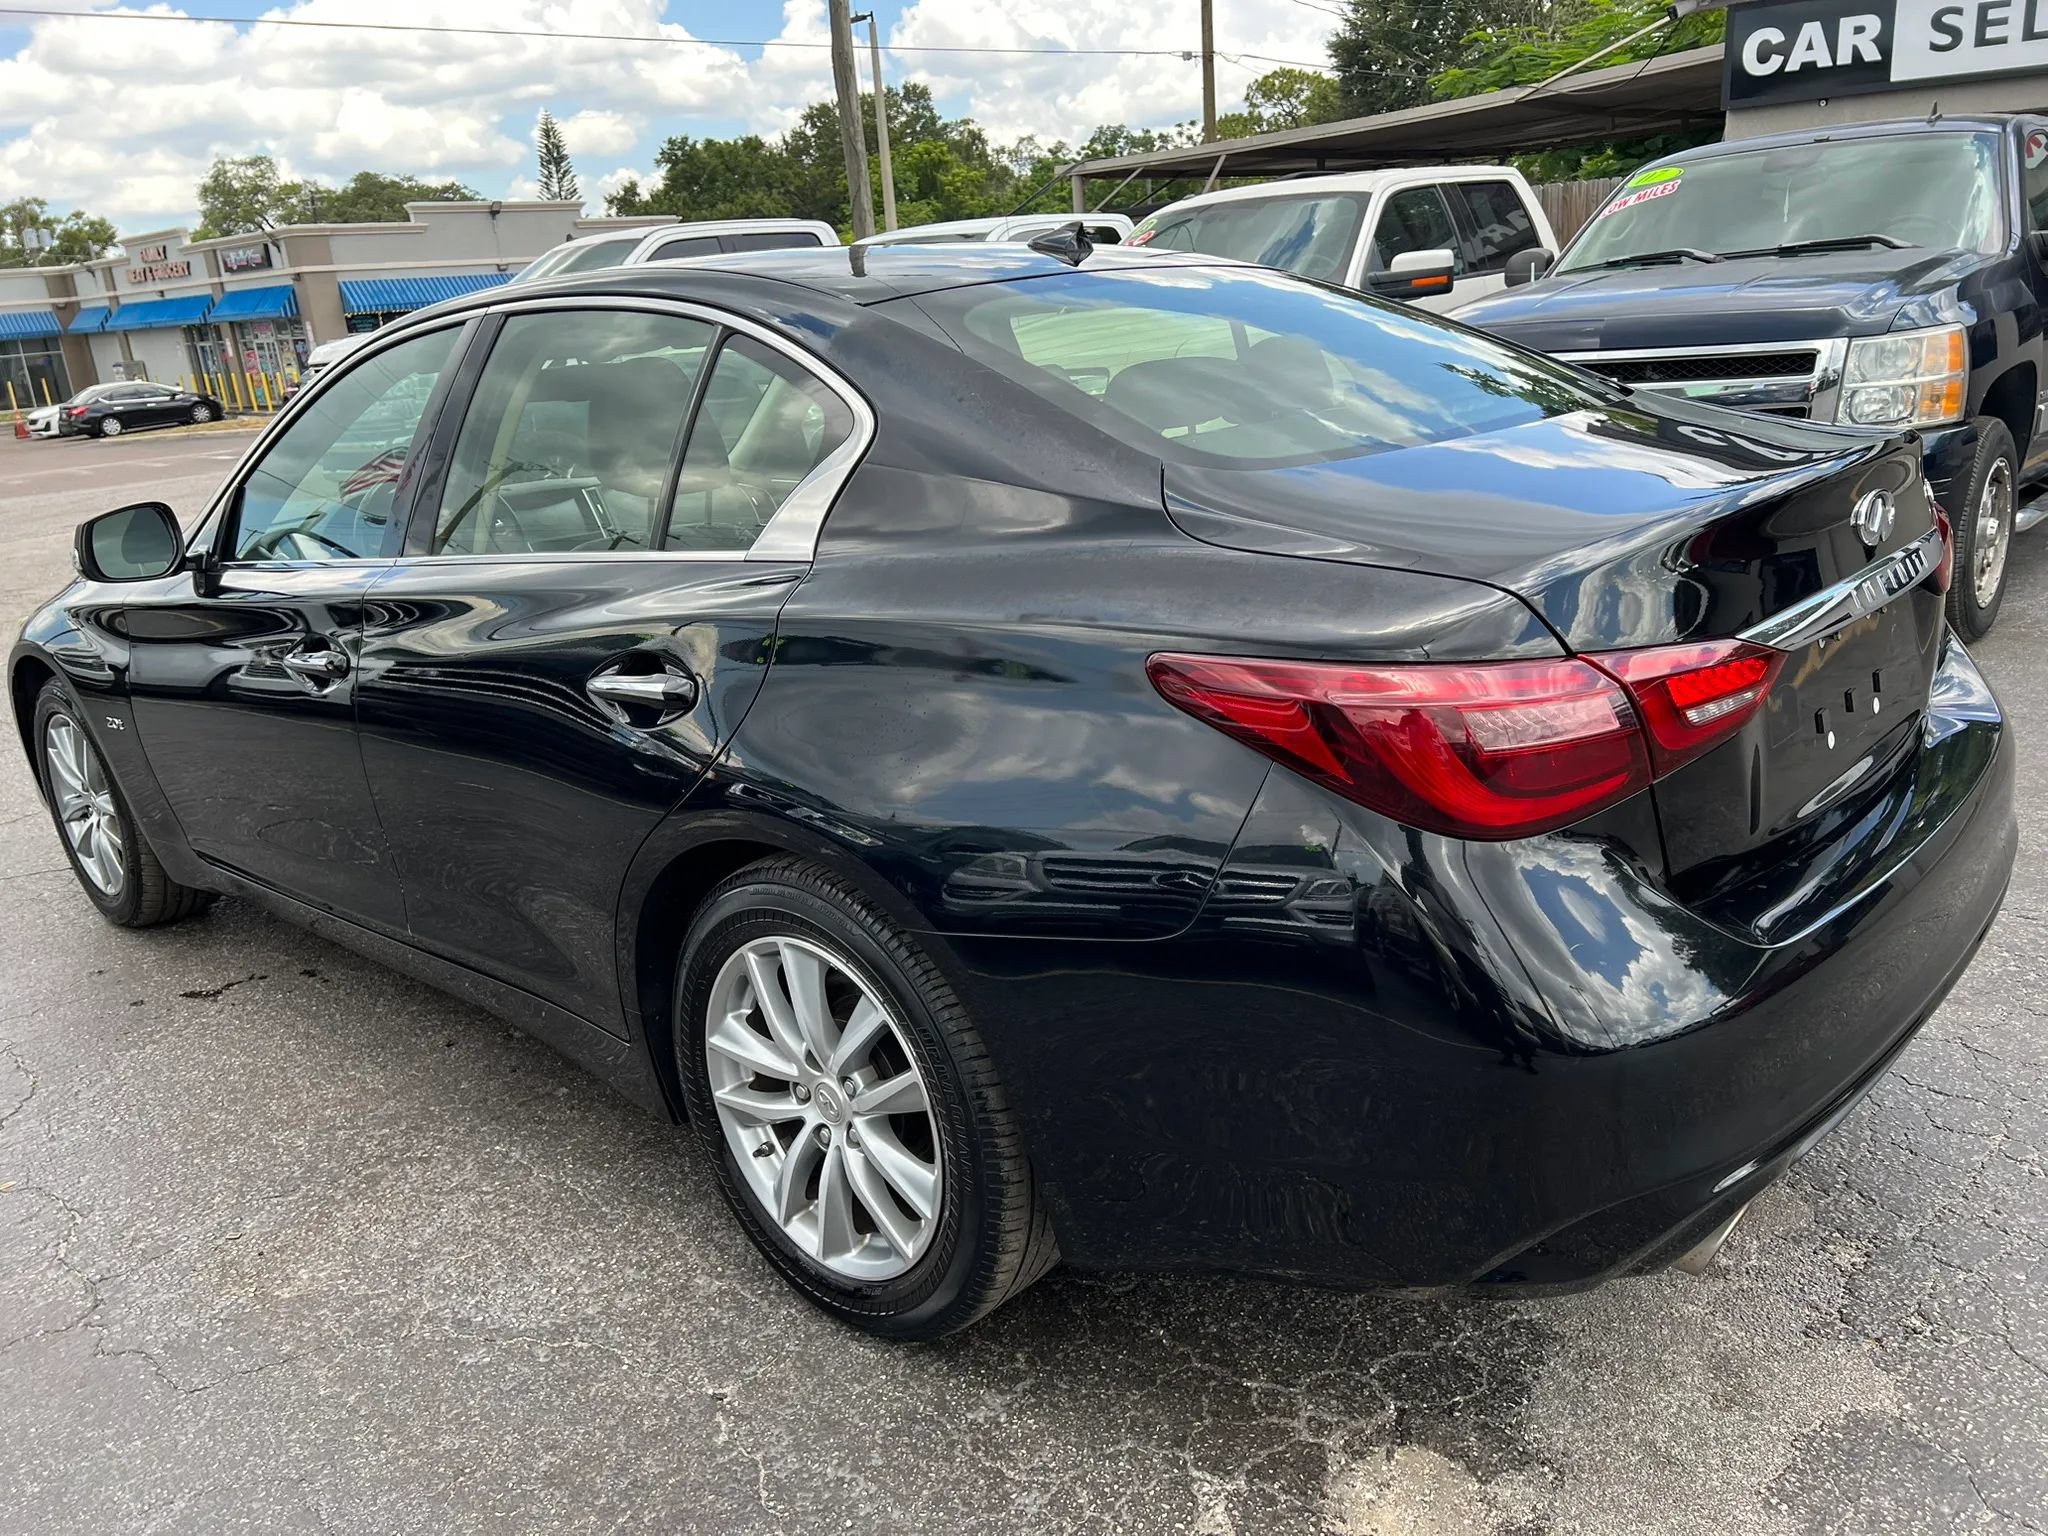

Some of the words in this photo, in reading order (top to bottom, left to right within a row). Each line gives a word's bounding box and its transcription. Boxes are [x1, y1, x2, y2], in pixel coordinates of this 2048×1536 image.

[1742, 13, 1882, 77] CAR
[1633, 181, 1680, 204] MILES
[140, 245, 168, 263] FAMILY
[154, 261, 192, 281] GROCERY
